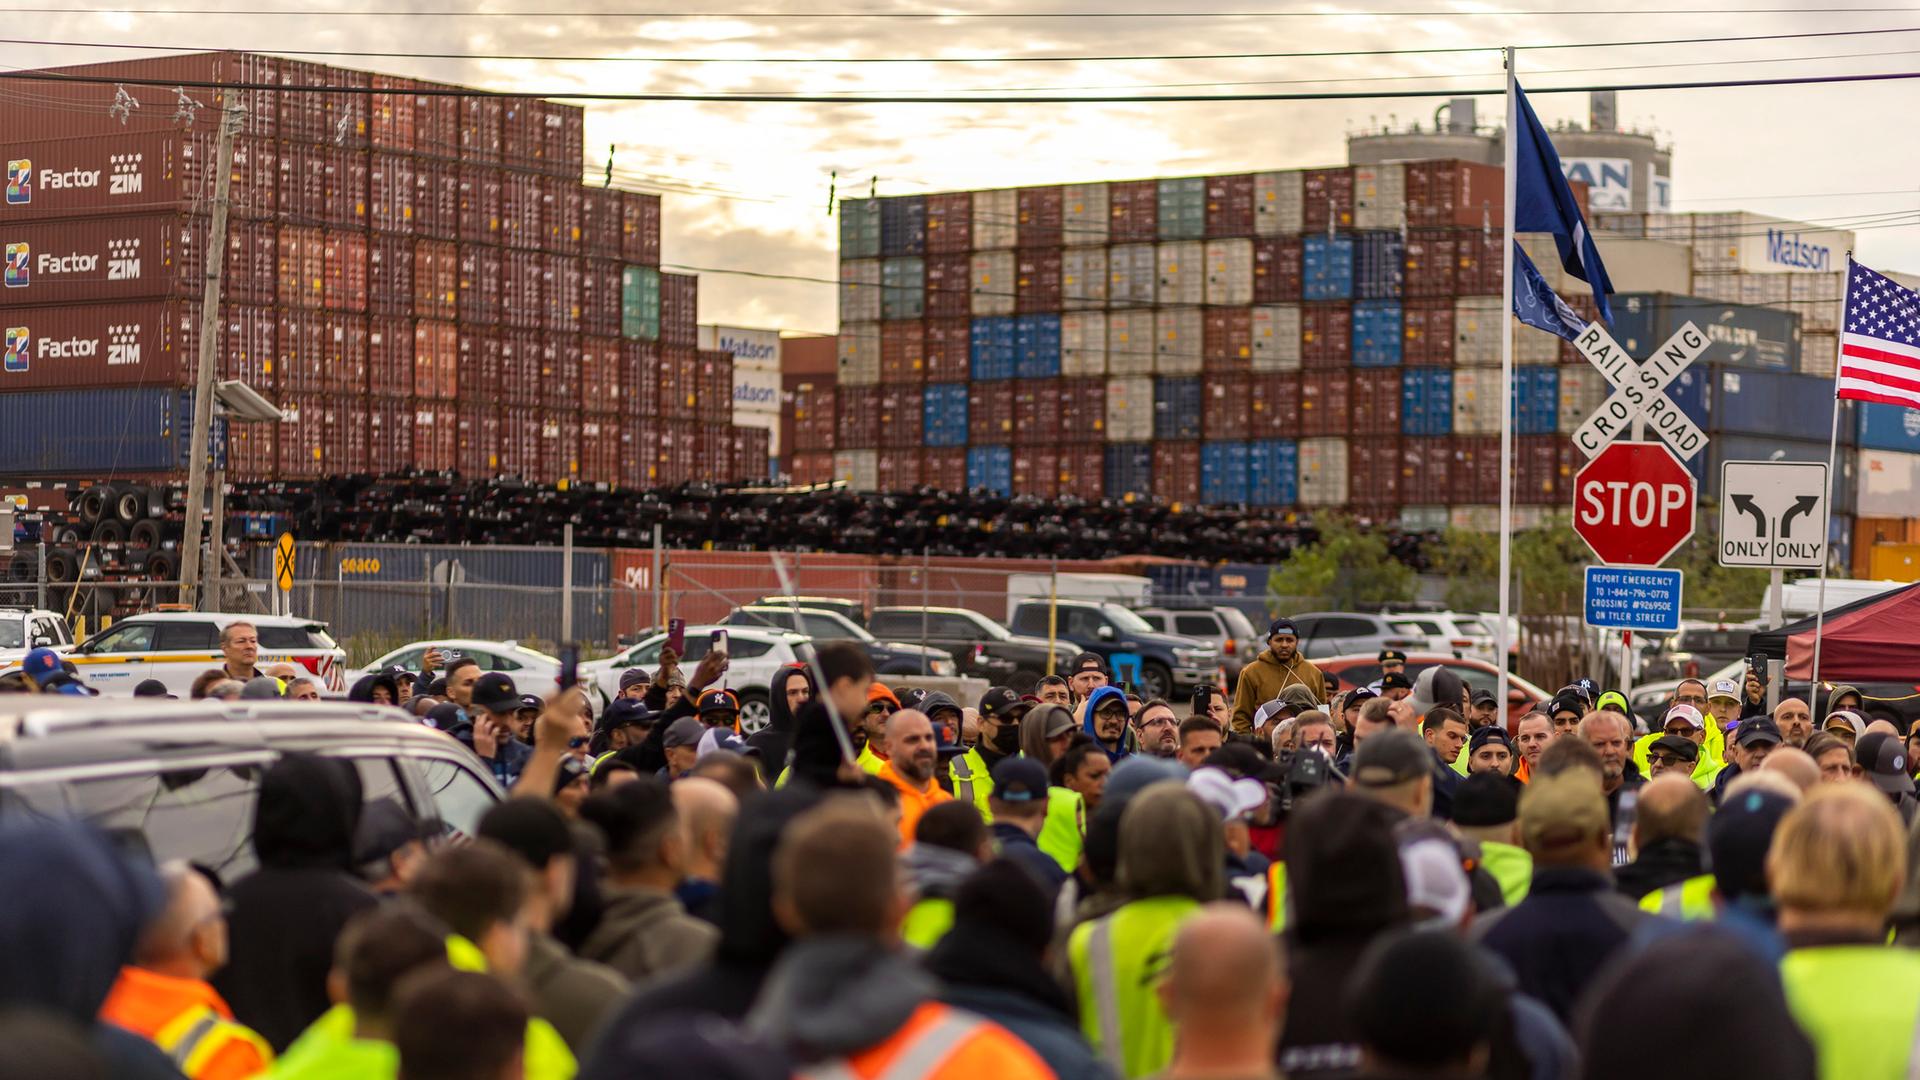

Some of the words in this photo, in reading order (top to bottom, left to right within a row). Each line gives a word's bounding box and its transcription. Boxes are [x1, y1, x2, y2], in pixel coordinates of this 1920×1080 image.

[40, 167, 101, 190] Factor
[109, 173, 143, 195] ZIM
[1561, 162, 1629, 189] AN
[1767, 228, 1830, 272] Matson
[38, 252, 99, 275] Factor
[107, 258, 141, 281] ZIM
[38, 336, 99, 359] Factor
[107, 343, 141, 365] ZIM
[721, 337, 776, 358] Matson
[734, 382, 776, 402] atson
[1580, 329, 1627, 384] RAIL
[1646, 398, 1699, 451] ROAD
[1580, 330, 1701, 451] CROSSING
[1581, 480, 1687, 528] STOP
[1724, 541, 1768, 557] ONLY
[1776, 542, 1821, 559] ONLY
[342, 558, 380, 573] seaco
[1592, 574, 1620, 584] REPORT
[1623, 575, 1673, 586] EMERGENCY
[1591, 598, 1628, 609] CROSSING
[1596, 587, 1605, 597] TO
[1608, 588, 1670, 599] 1-844-796-0778
[1595, 611, 1606, 620] ON
[1609, 611, 1632, 621] TYLER
[1636, 613, 1666, 623] STREET
